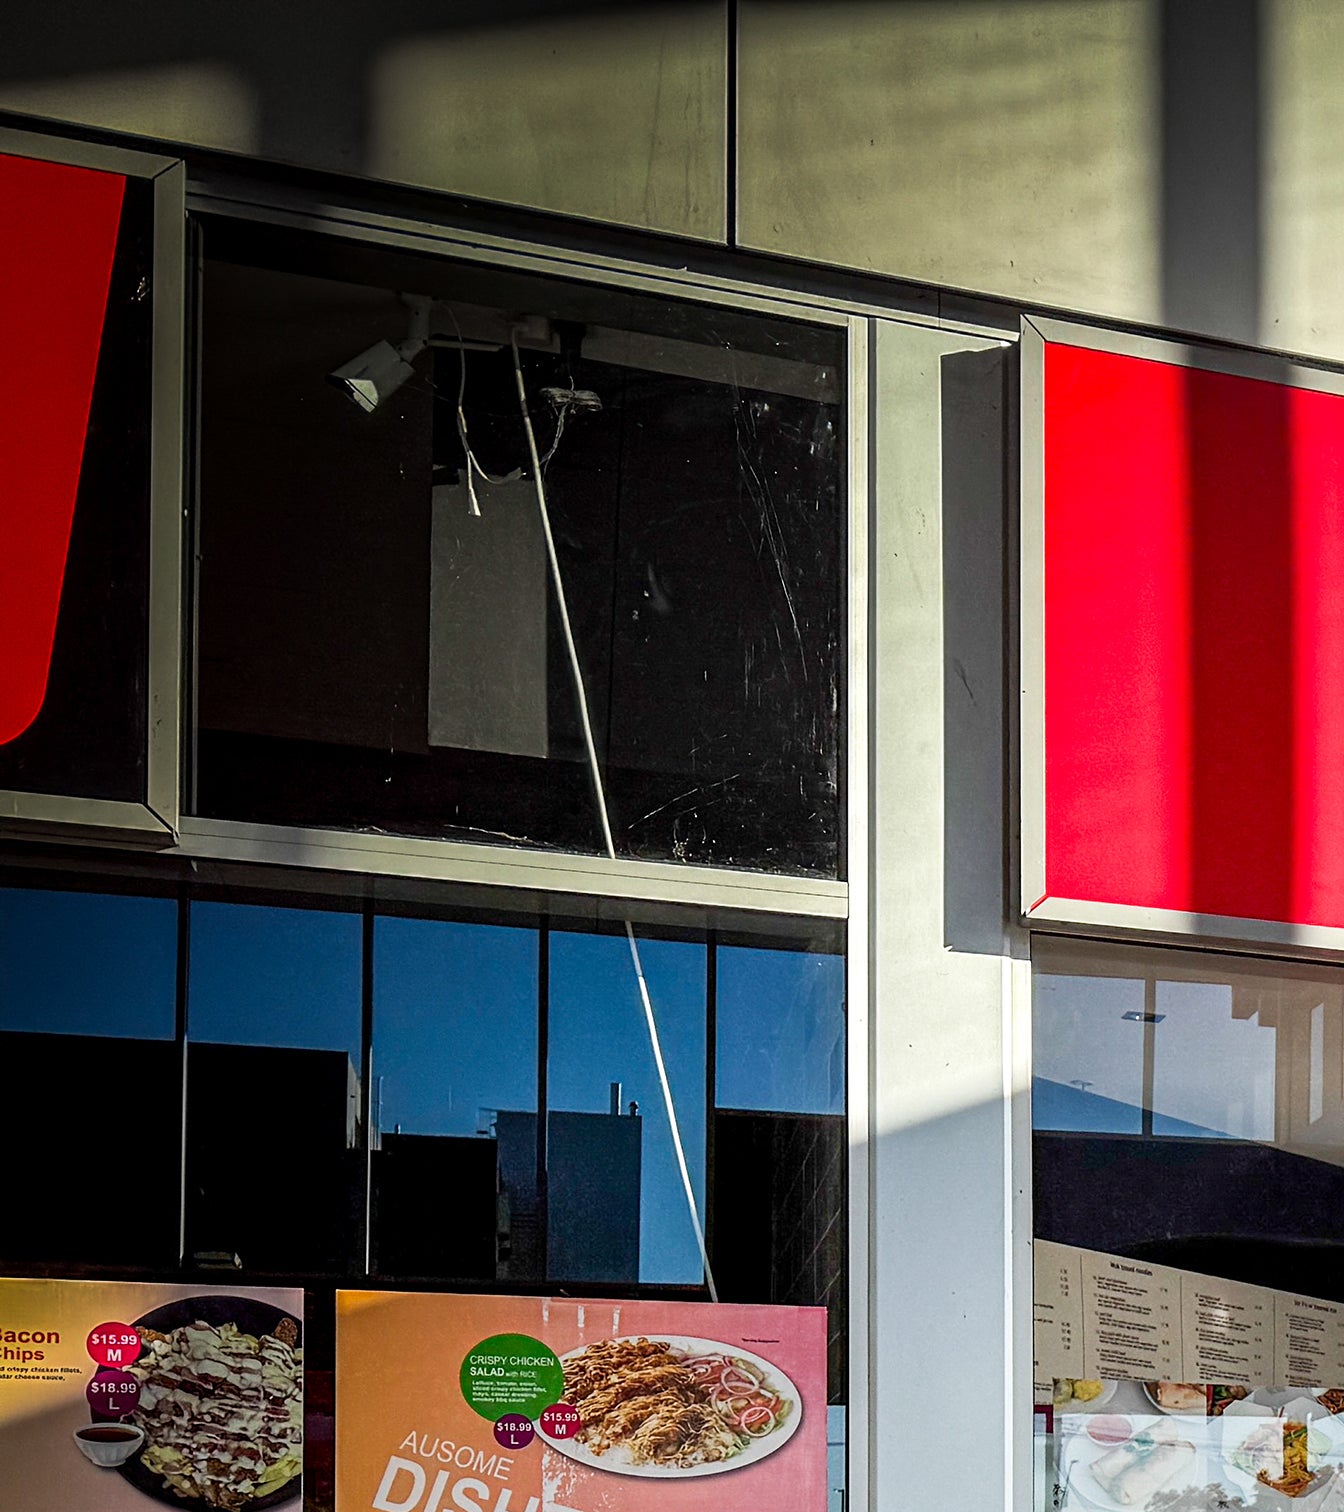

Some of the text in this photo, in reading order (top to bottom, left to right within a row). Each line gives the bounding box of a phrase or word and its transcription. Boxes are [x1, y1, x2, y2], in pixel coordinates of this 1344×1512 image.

[91, 1333, 138, 1346] $15.99
[470, 1355, 555, 1366] CRISPY CHICKEN
[470, 1367, 504, 1377] SALAD
[91, 1382, 137, 1394] $18.99
[543, 1413, 578, 1423] $15.99
[497, 1422, 532, 1432] $18.99
[399, 1430, 514, 1480] AUSOME
